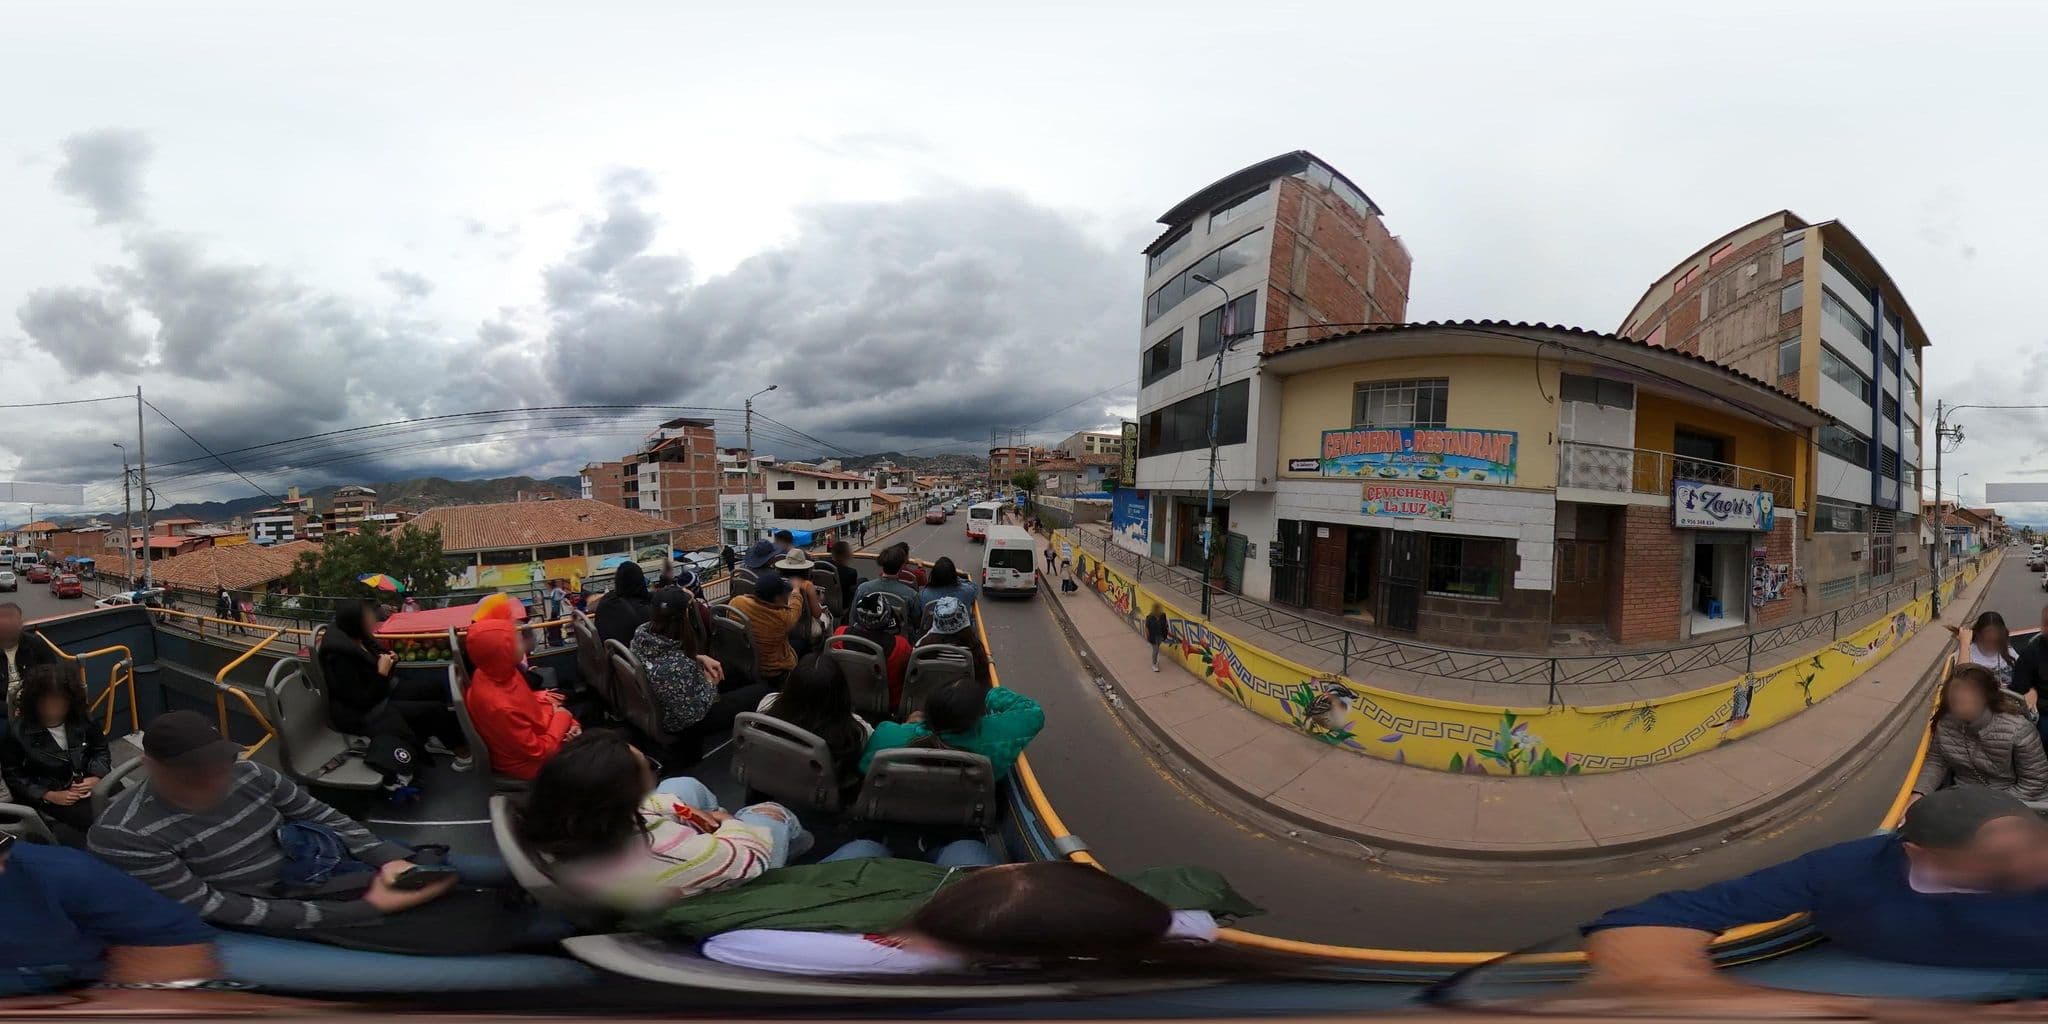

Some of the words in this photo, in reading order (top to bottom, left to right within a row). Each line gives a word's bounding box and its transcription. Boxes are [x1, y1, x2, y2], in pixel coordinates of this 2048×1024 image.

[1324, 430, 1402, 460] CEVICHERIA
[1413, 430, 1513, 466] RESTAURANT
[1367, 486, 1447, 507] CEVICHERIA
[1385, 501, 1398, 512] La
[1401, 501, 1427, 514] LUZ
